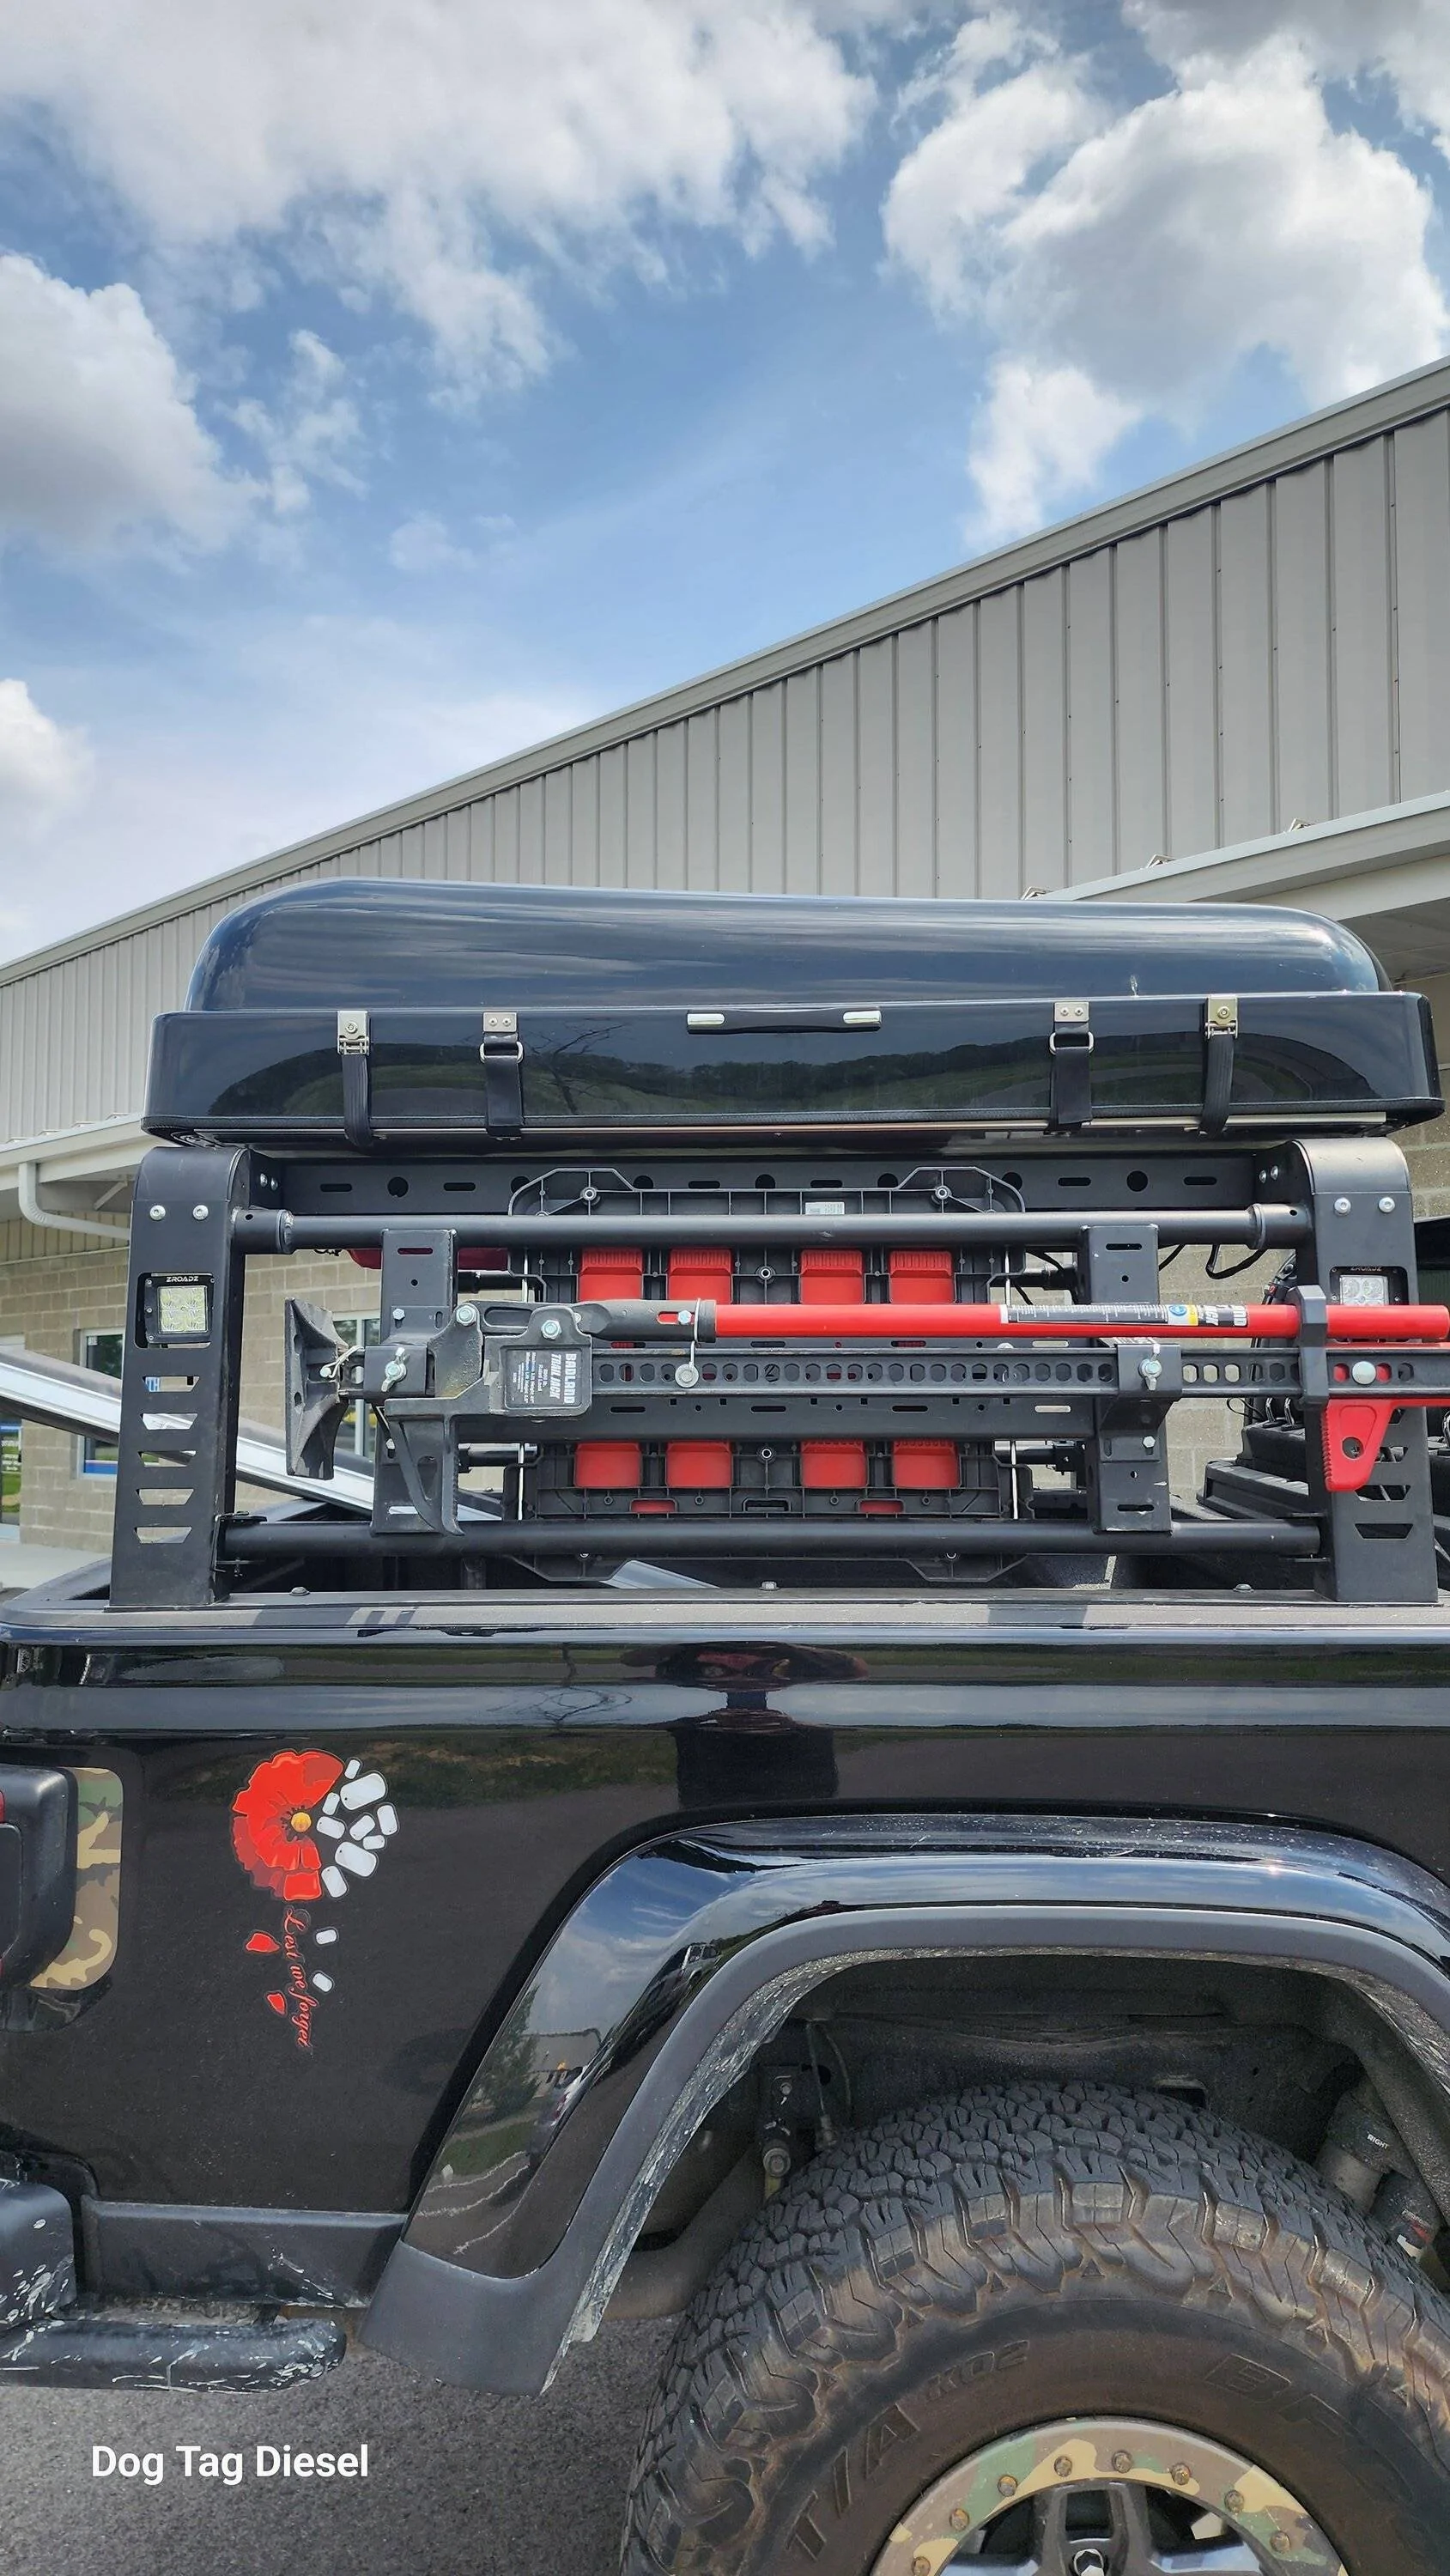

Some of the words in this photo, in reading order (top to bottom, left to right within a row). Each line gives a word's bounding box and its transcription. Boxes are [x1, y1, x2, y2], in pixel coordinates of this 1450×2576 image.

[550, 1353, 561, 1377] TRAIL
[549, 1376, 561, 1400] JACK
[563, 1353, 577, 1404] BADLAND
[284, 1908, 306, 1960] Lest
[290, 1965, 306, 1990] we
[288, 1986, 318, 2048] forget
[1367, 2133, 1390, 2150] RIGHT
